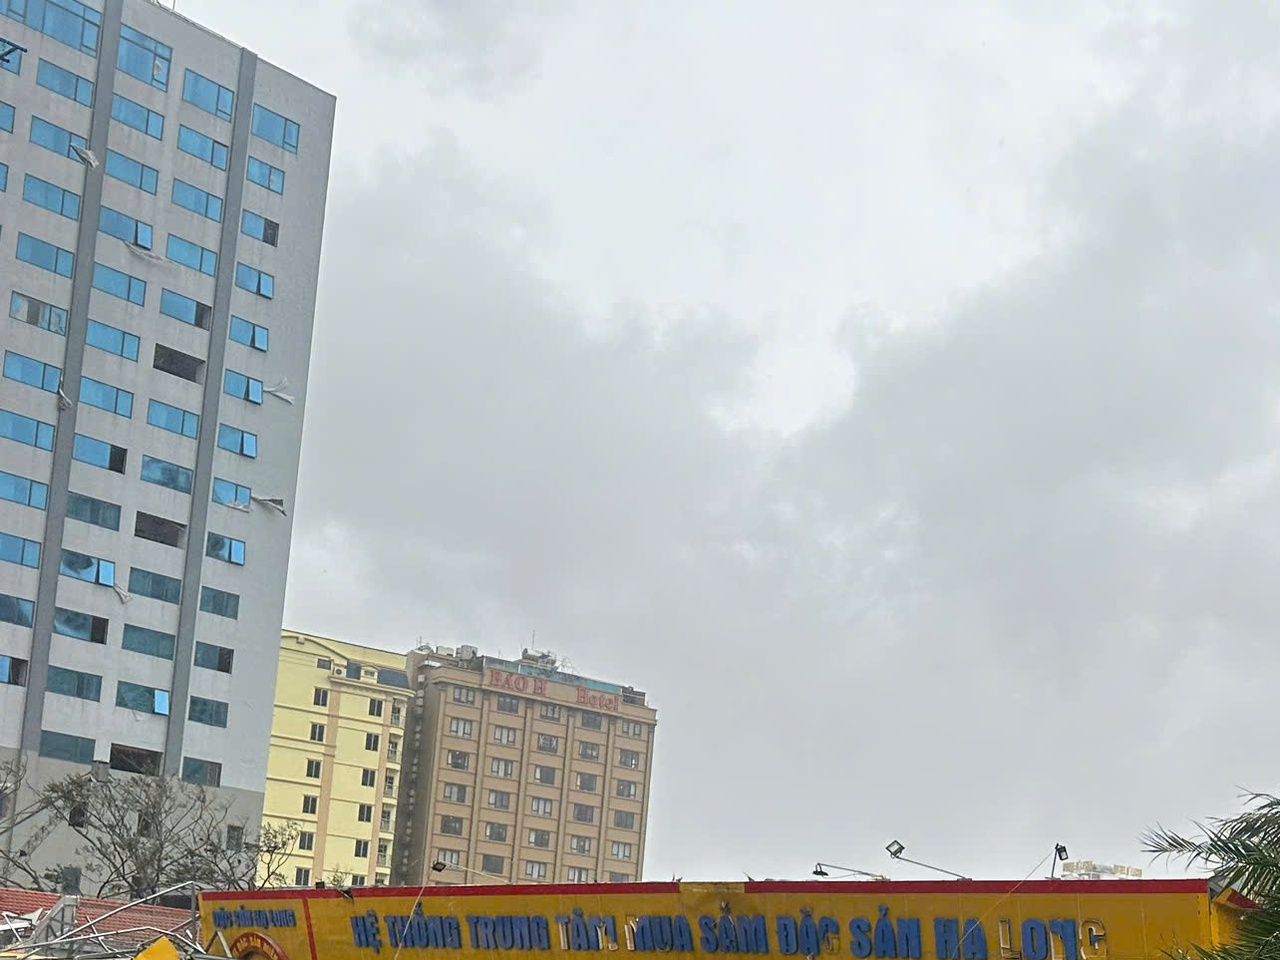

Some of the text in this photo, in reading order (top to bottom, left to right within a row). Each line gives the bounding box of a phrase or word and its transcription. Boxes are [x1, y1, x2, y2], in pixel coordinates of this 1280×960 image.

[576, 686, 620, 711] Hotel
[465, 915, 551, 951] TRUNG
[625, 914, 694, 953] MUA
